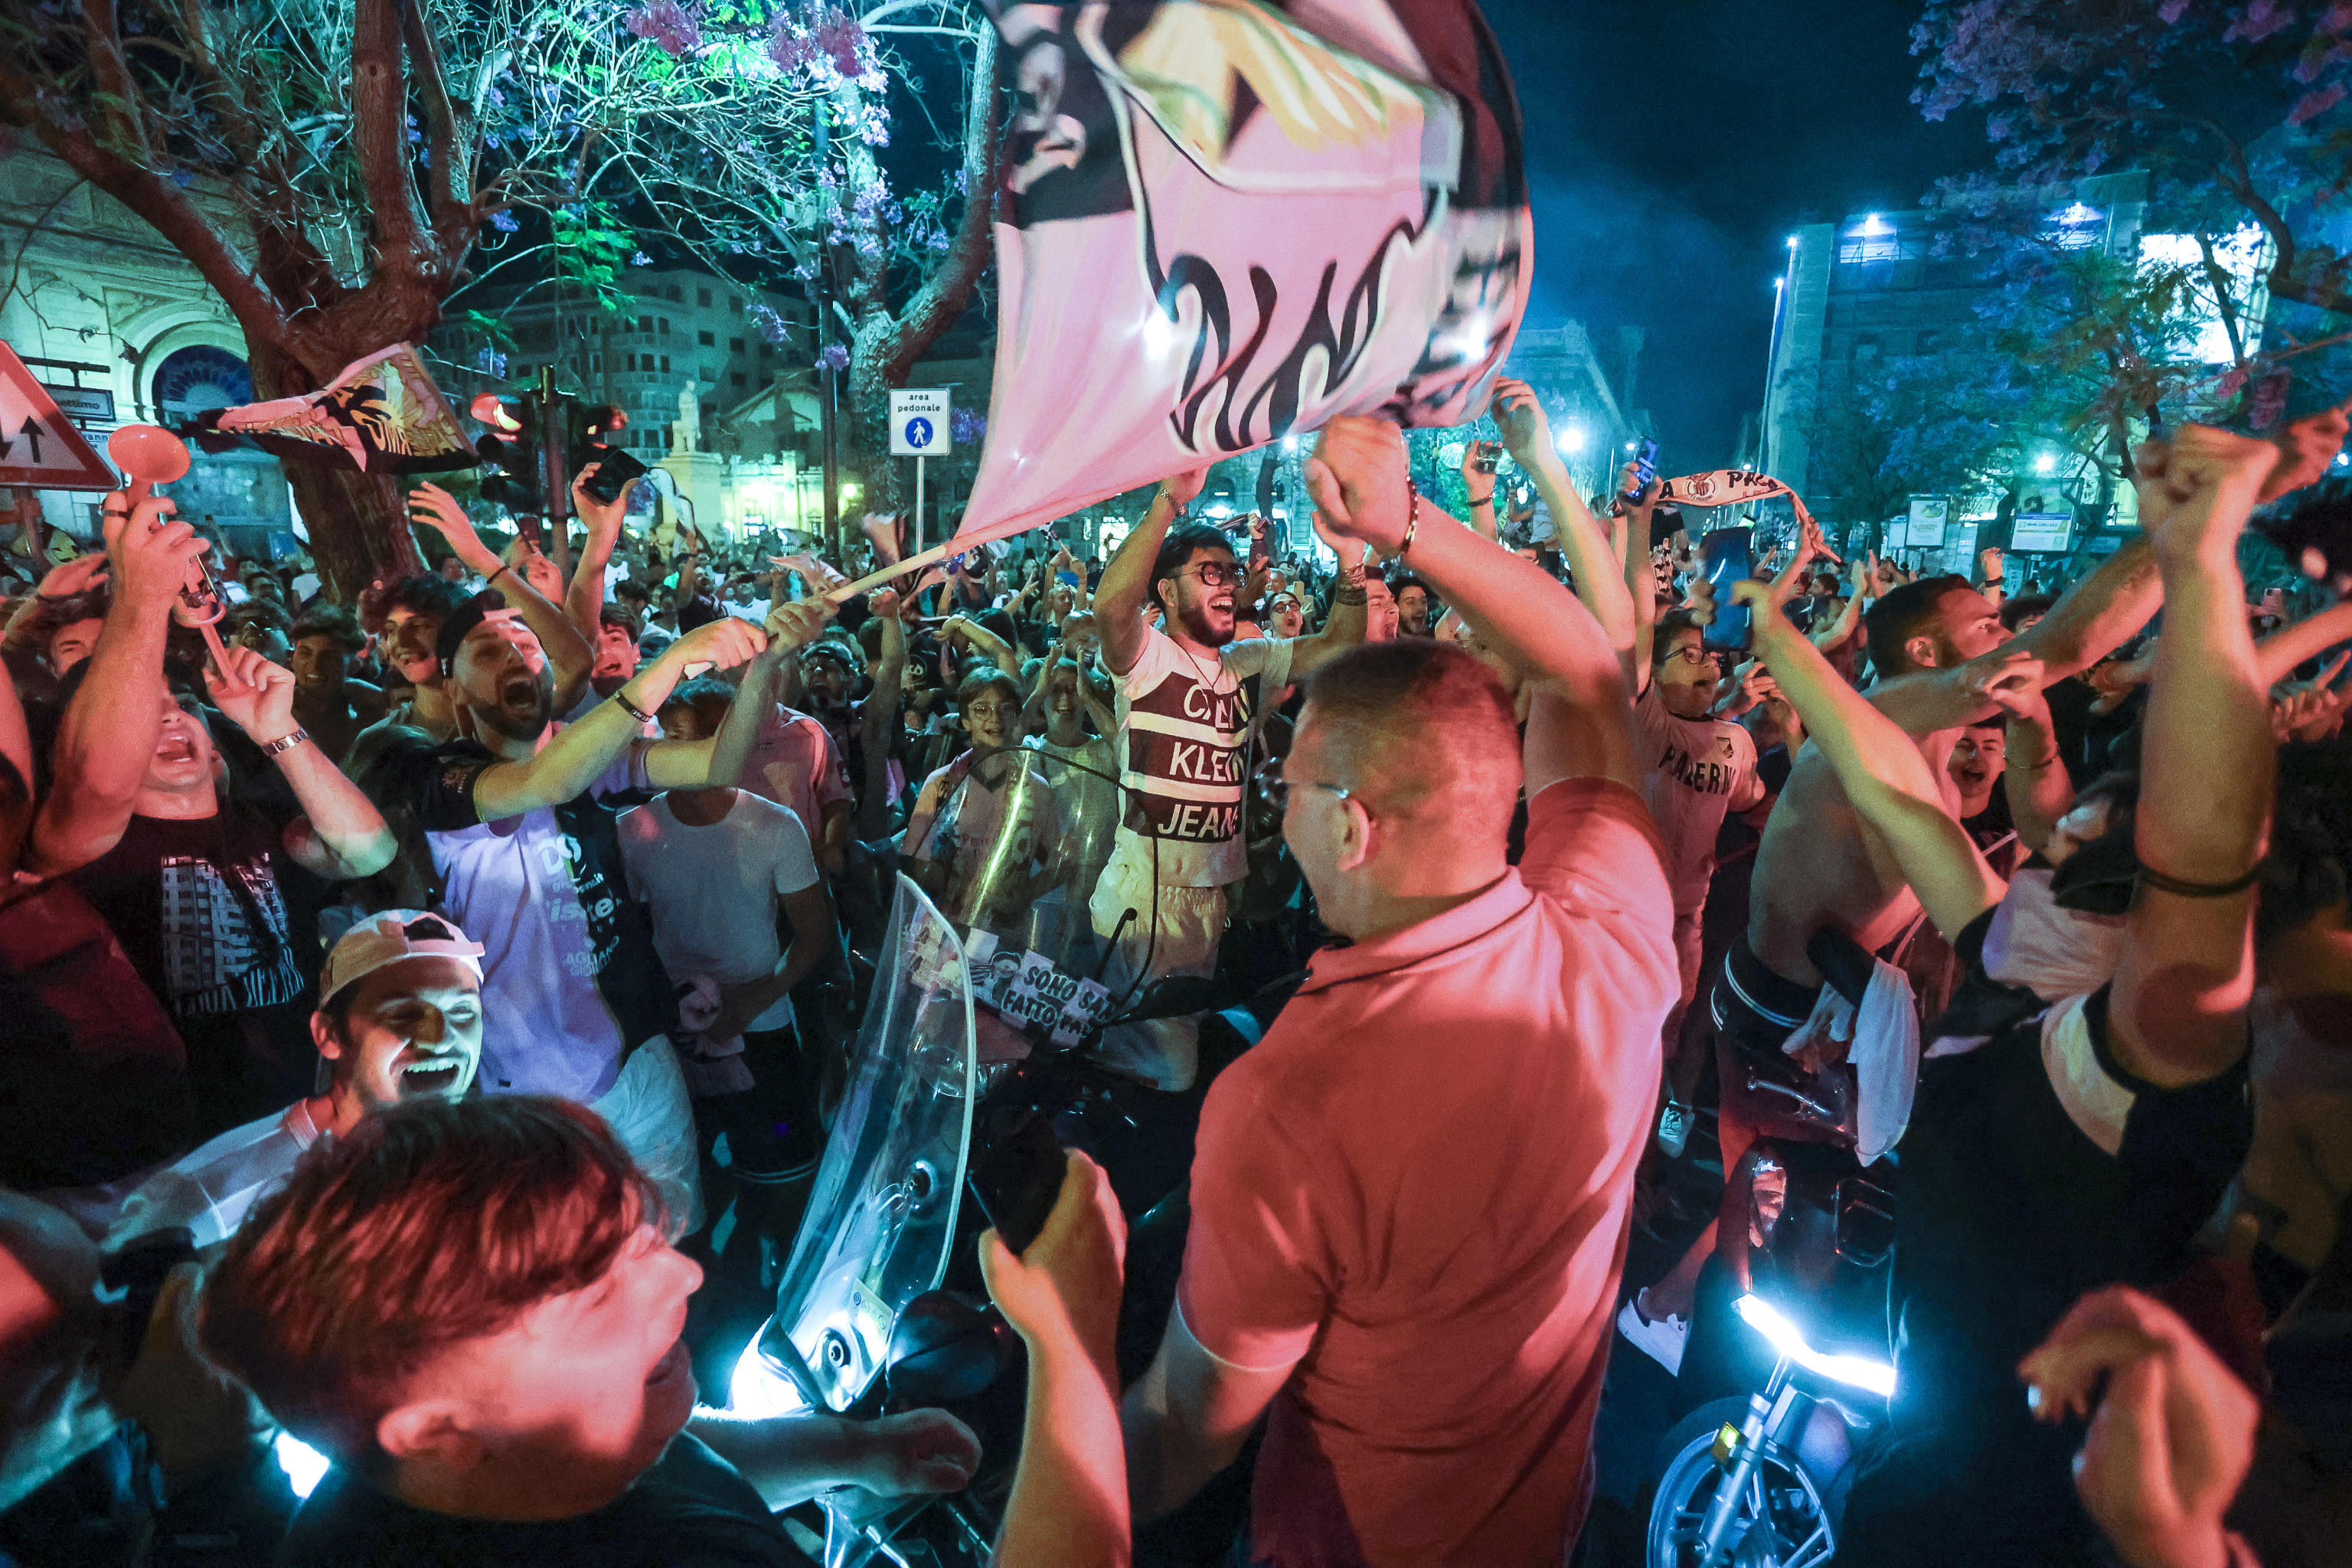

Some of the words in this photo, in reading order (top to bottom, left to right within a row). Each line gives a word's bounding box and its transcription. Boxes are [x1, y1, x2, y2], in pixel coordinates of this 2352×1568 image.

[897, 403, 941, 413] pedonale
[1157, 804, 1239, 838] JEAN
[1023, 965, 1078, 1001] SONO
[1002, 989, 1058, 1024] FATTO
